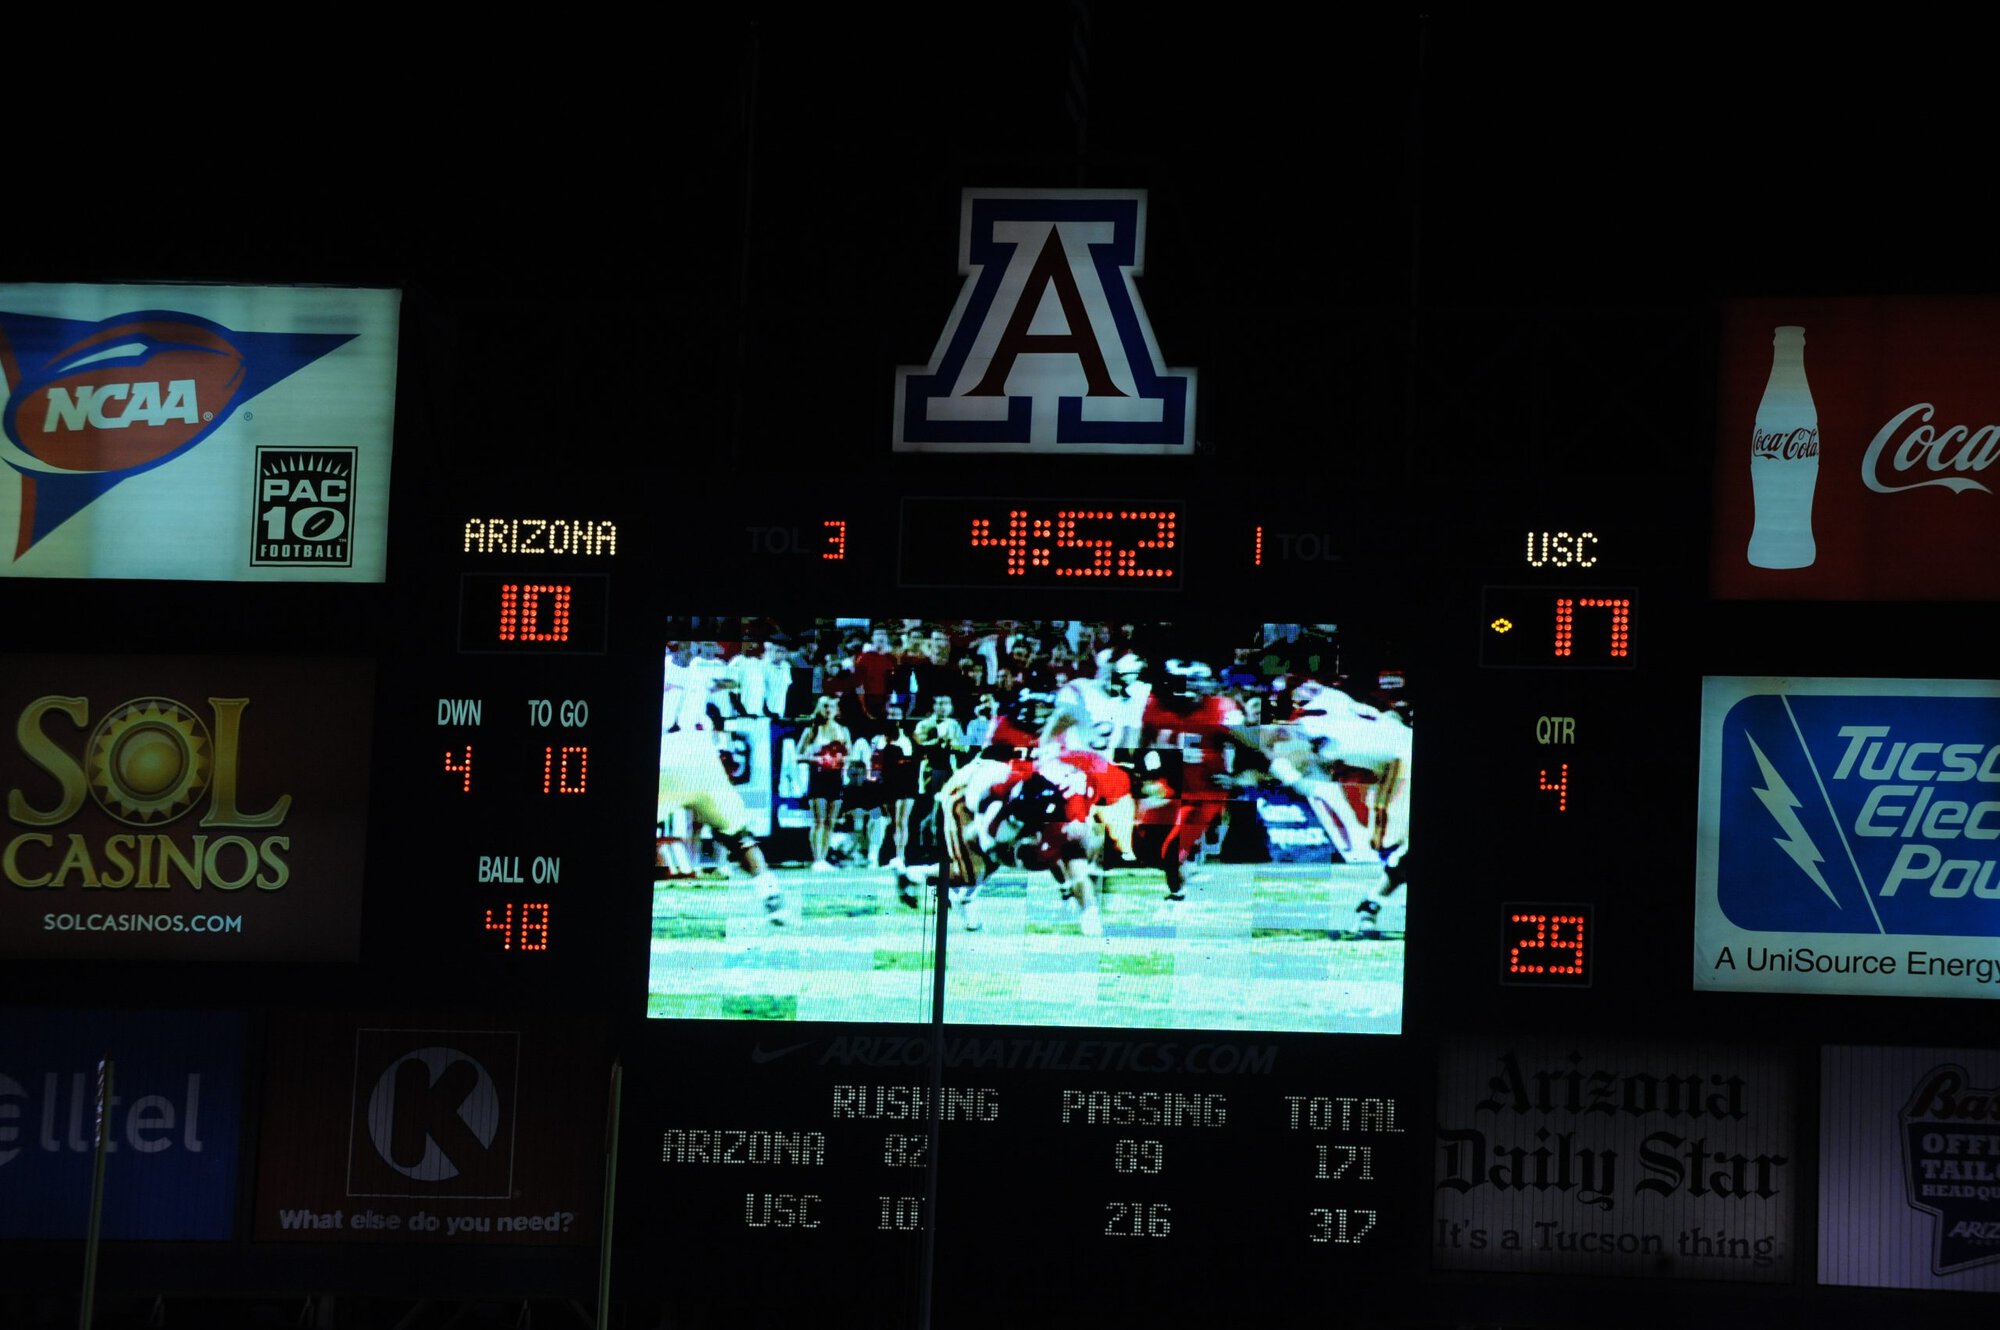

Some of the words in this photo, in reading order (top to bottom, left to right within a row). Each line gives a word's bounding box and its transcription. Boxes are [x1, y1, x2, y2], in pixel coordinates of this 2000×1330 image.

[892, 186, 1198, 455] A
[43, 379, 199, 433] NCAA
[1753, 427, 1818, 460] Coca-Cola
[263, 479, 347, 503] PAC
[262, 506, 346, 542] 10
[463, 518, 617, 556] ARIZONA
[746, 526, 808, 555] TOL
[819, 520, 846, 561] 3
[970, 509, 1176, 578] 4:52
[1254, 523, 1264, 567] 1
[260, 544, 343, 558] FOOTBALL
[1276, 532, 1341, 563] TOL
[1527, 531, 1598, 568] USC
[499, 584, 573, 642] 10
[1554, 597, 1631, 658] 17
[437, 699, 482, 726] DWN
[528, 699, 553, 727] TO
[559, 699, 589, 728] GO
[1535, 715, 1576, 746] QTR
[7, 694, 293, 828] SOL
[443, 745, 473, 794] 4
[543, 745, 589, 795] 10
[1538, 762, 1568, 813] 4
[1854, 785, 2000, 840] Elec
[2, 832, 291, 892] CASINOS
[478, 856, 523, 884] BALL
[531, 857, 560, 885] ON
[43, 913, 243, 934] SOLCASINOS.COM
[484, 902, 550, 951] 48
[1510, 913, 1585, 976] 29
[1715, 947, 1736, 971] A
[1746, 949, 1896, 975] UniSource
[819, 1034, 1279, 1075] ARIZONAATHLETICS.COM
[1476, 1051, 1748, 1120] Arizona
[833, 1085, 999, 1122] RUSHING
[1062, 1089, 1230, 1129] PASSING
[1283, 1095, 1406, 1135] TOTAL
[662, 1129, 827, 1167] ARIZONA
[884, 1133, 928, 1168] 82
[1113, 1138, 1165, 1175] 89
[1312, 1143, 1375, 1182] 171
[1436, 1127, 1618, 1211] Daily
[1634, 1131, 1789, 1200] Star
[279, 1208, 344, 1231] What
[350, 1209, 400, 1231] else
[408, 1211, 440, 1232] do
[446, 1215, 490, 1236] you
[497, 1211, 575, 1232] need?
[744, 1192, 823, 1231] USC
[877, 1196, 926, 1231] 10
[1104, 1201, 1173, 1239] 216
[1309, 1207, 1378, 1245] 317
[1436, 1219, 1488, 1249] It's
[1501, 1229, 1521, 1250] a
[1535, 1221, 1664, 1255] Tucson
